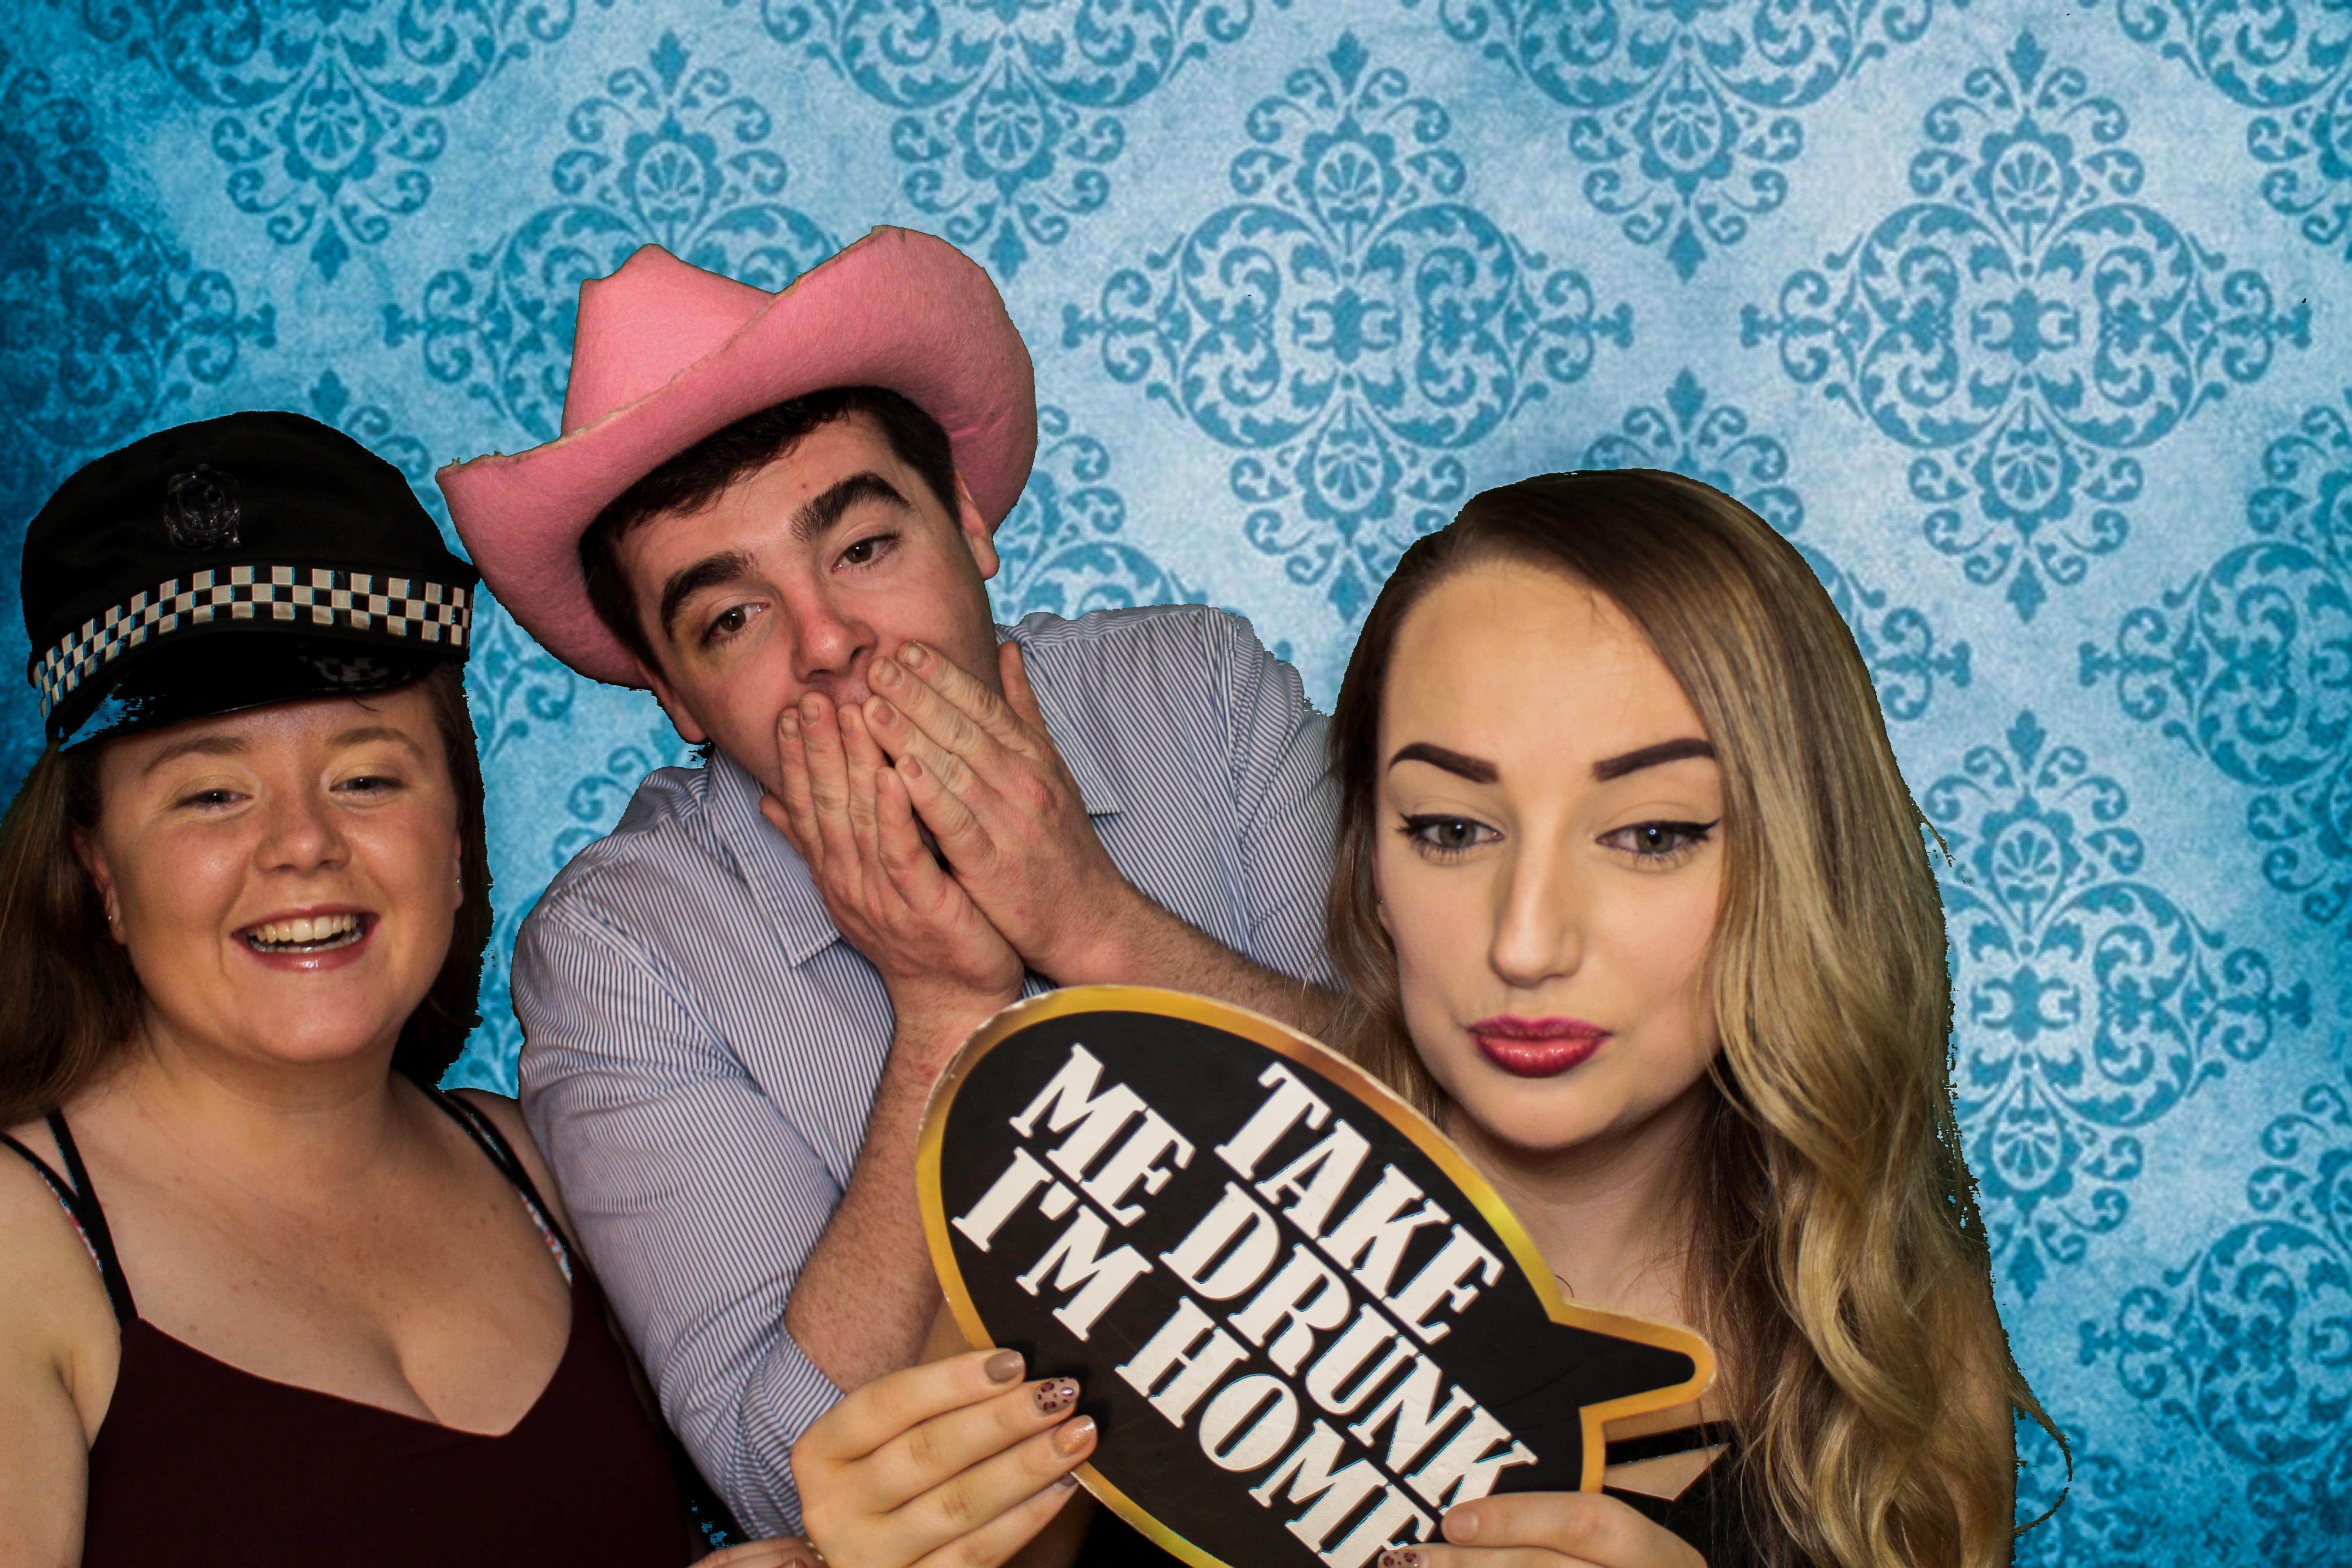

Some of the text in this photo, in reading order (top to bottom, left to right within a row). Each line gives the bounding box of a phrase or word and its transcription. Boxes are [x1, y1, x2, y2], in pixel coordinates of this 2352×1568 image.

[951, 1146, 1435, 1568] I'M HOME
[1008, 1042, 1538, 1516] ME DRUNK
[1214, 1061, 1504, 1345] TAKE
